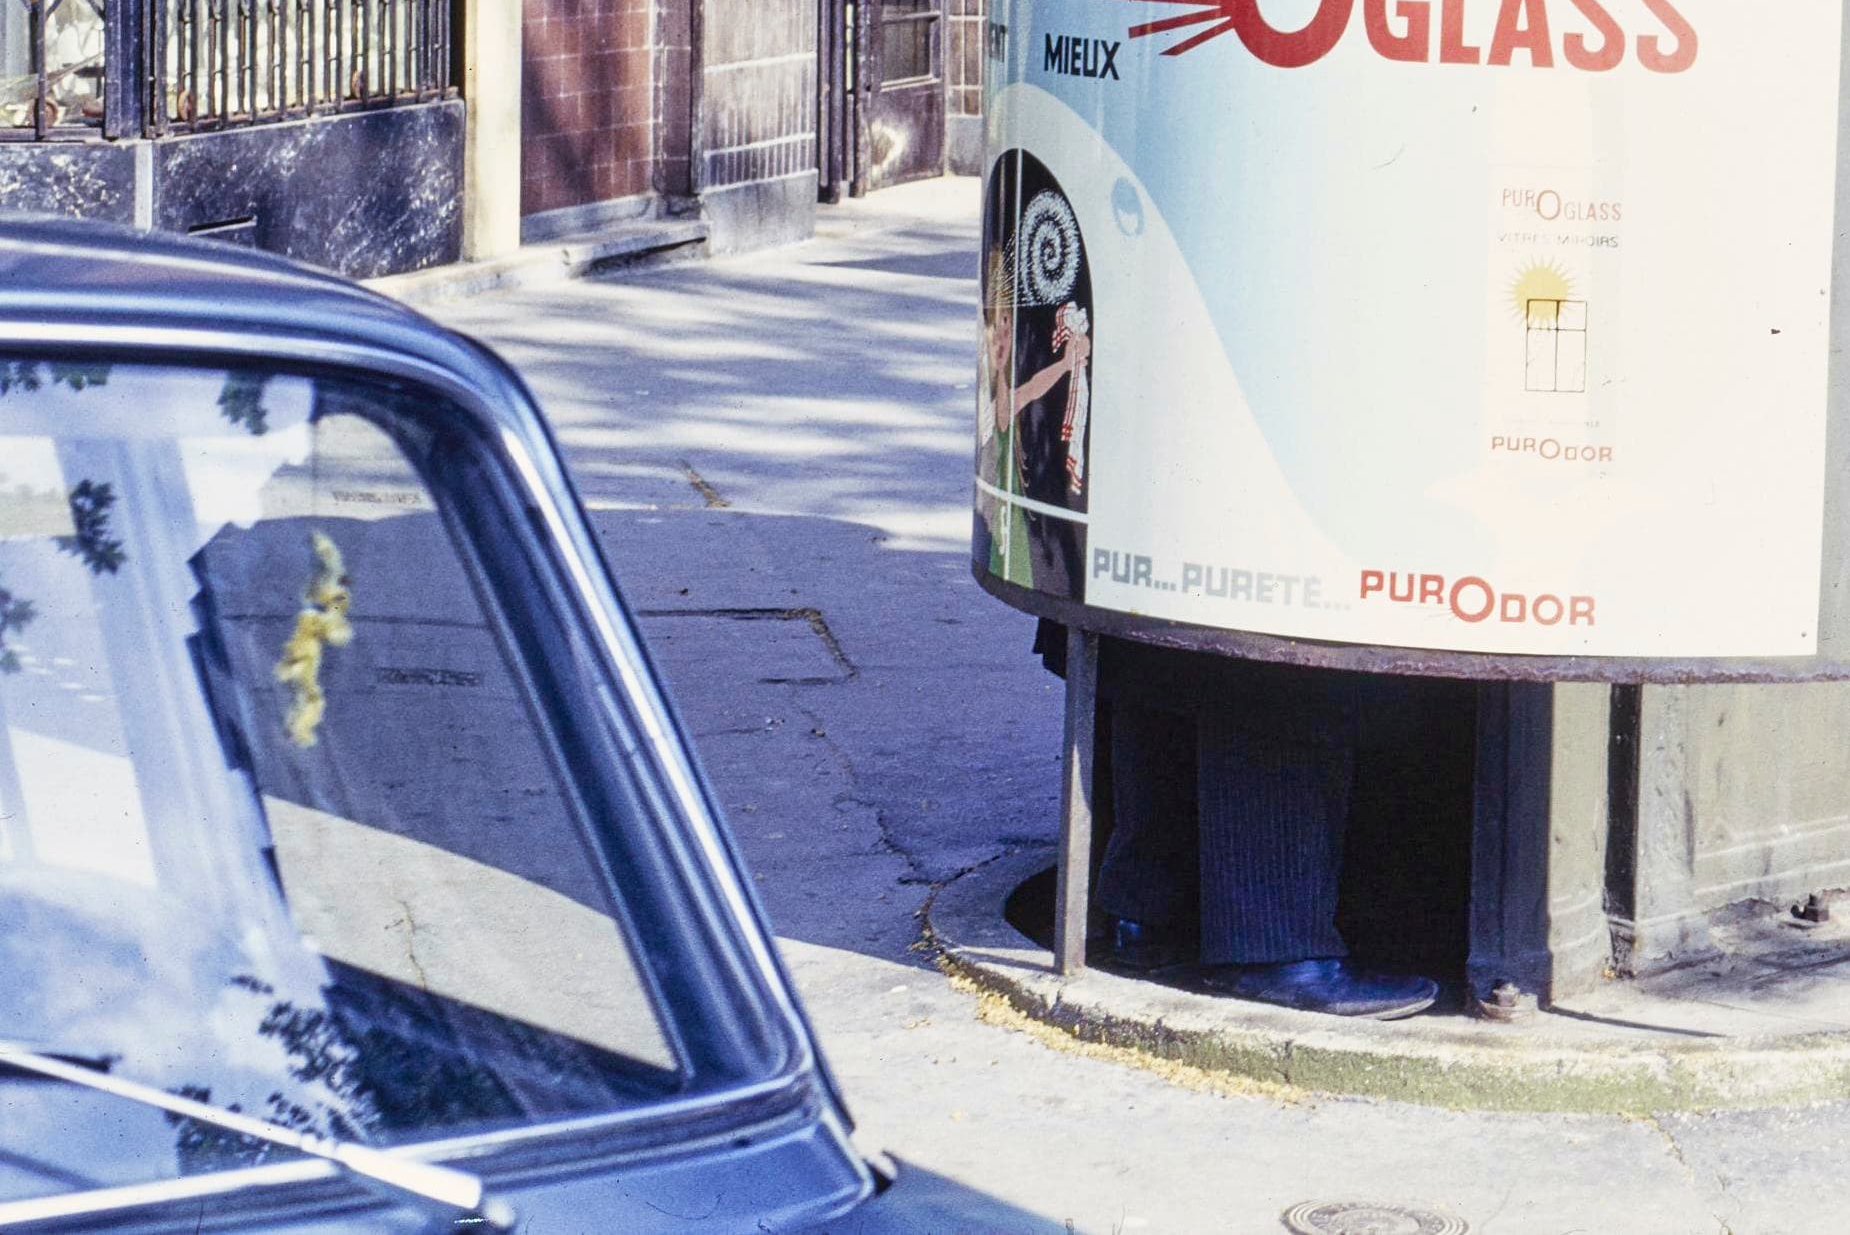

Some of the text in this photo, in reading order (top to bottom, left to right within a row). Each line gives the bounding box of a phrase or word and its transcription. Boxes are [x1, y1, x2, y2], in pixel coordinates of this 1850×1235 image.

[1043, 32, 1122, 81] MIEUX
[1502, 188, 1622, 222] PUROGLASS
[1491, 435, 1613, 462] PURODOR
[1360, 569, 1596, 626] PURODOR
